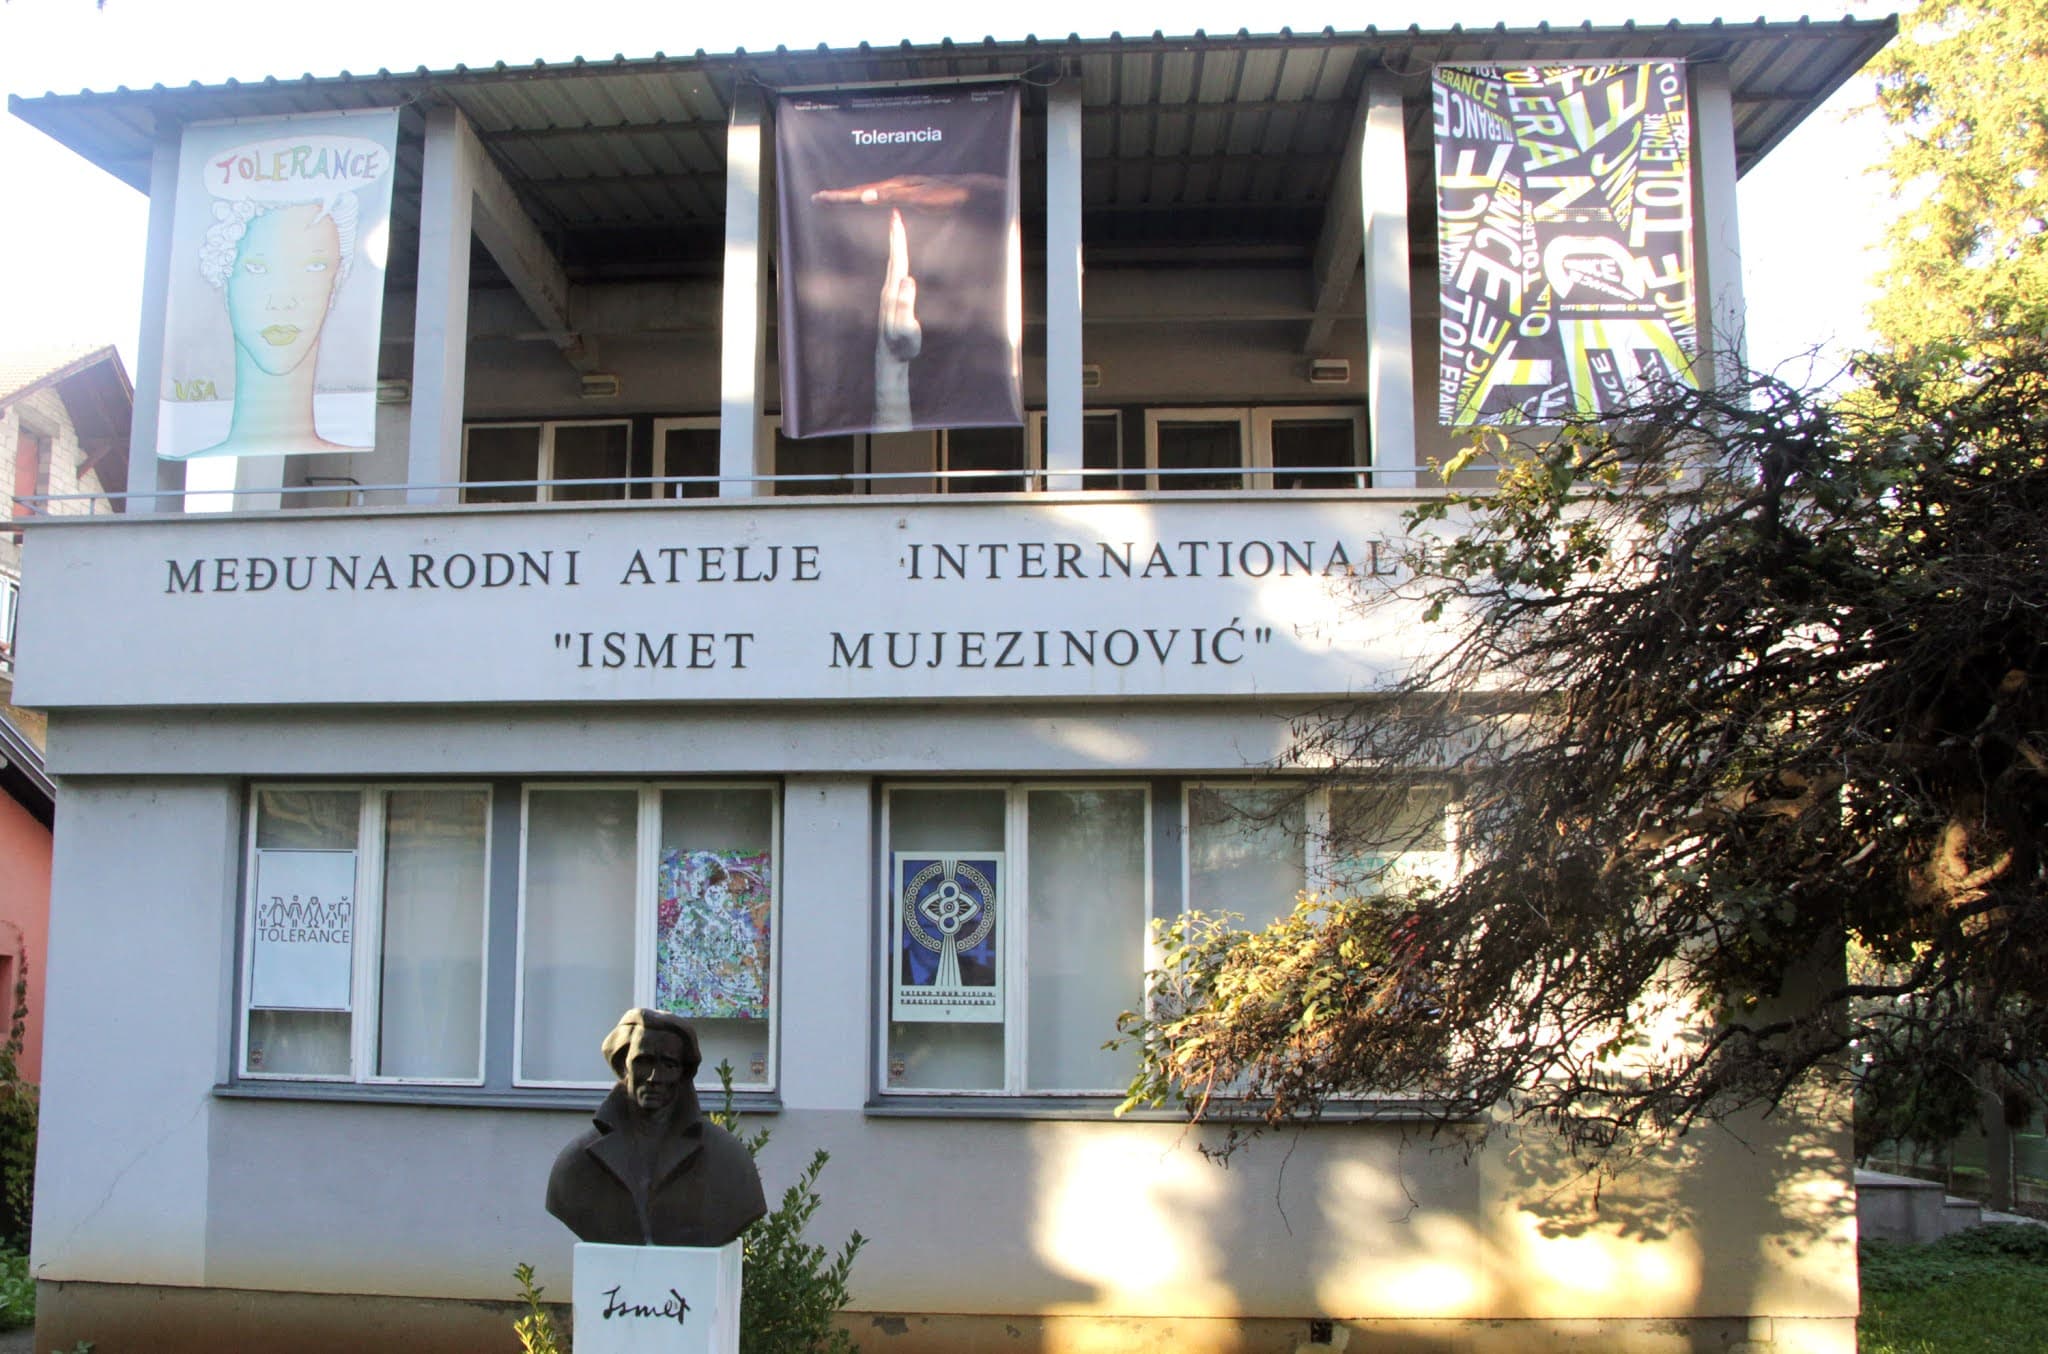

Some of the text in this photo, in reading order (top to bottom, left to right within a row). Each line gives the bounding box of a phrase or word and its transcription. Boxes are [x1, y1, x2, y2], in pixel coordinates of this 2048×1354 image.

[851, 126, 942, 145] Tolerancia
[216, 145, 378, 184] TOLERANCE
[165, 540, 1400, 593] MEĐUNARODNI ATELJE INTERNATIONAL
[553, 617, 1272, 669] "ISMET MUJEZINOVIĆ"
[259, 927, 351, 944] TOLERANCE
[602, 1285, 691, 1325] Ismet
